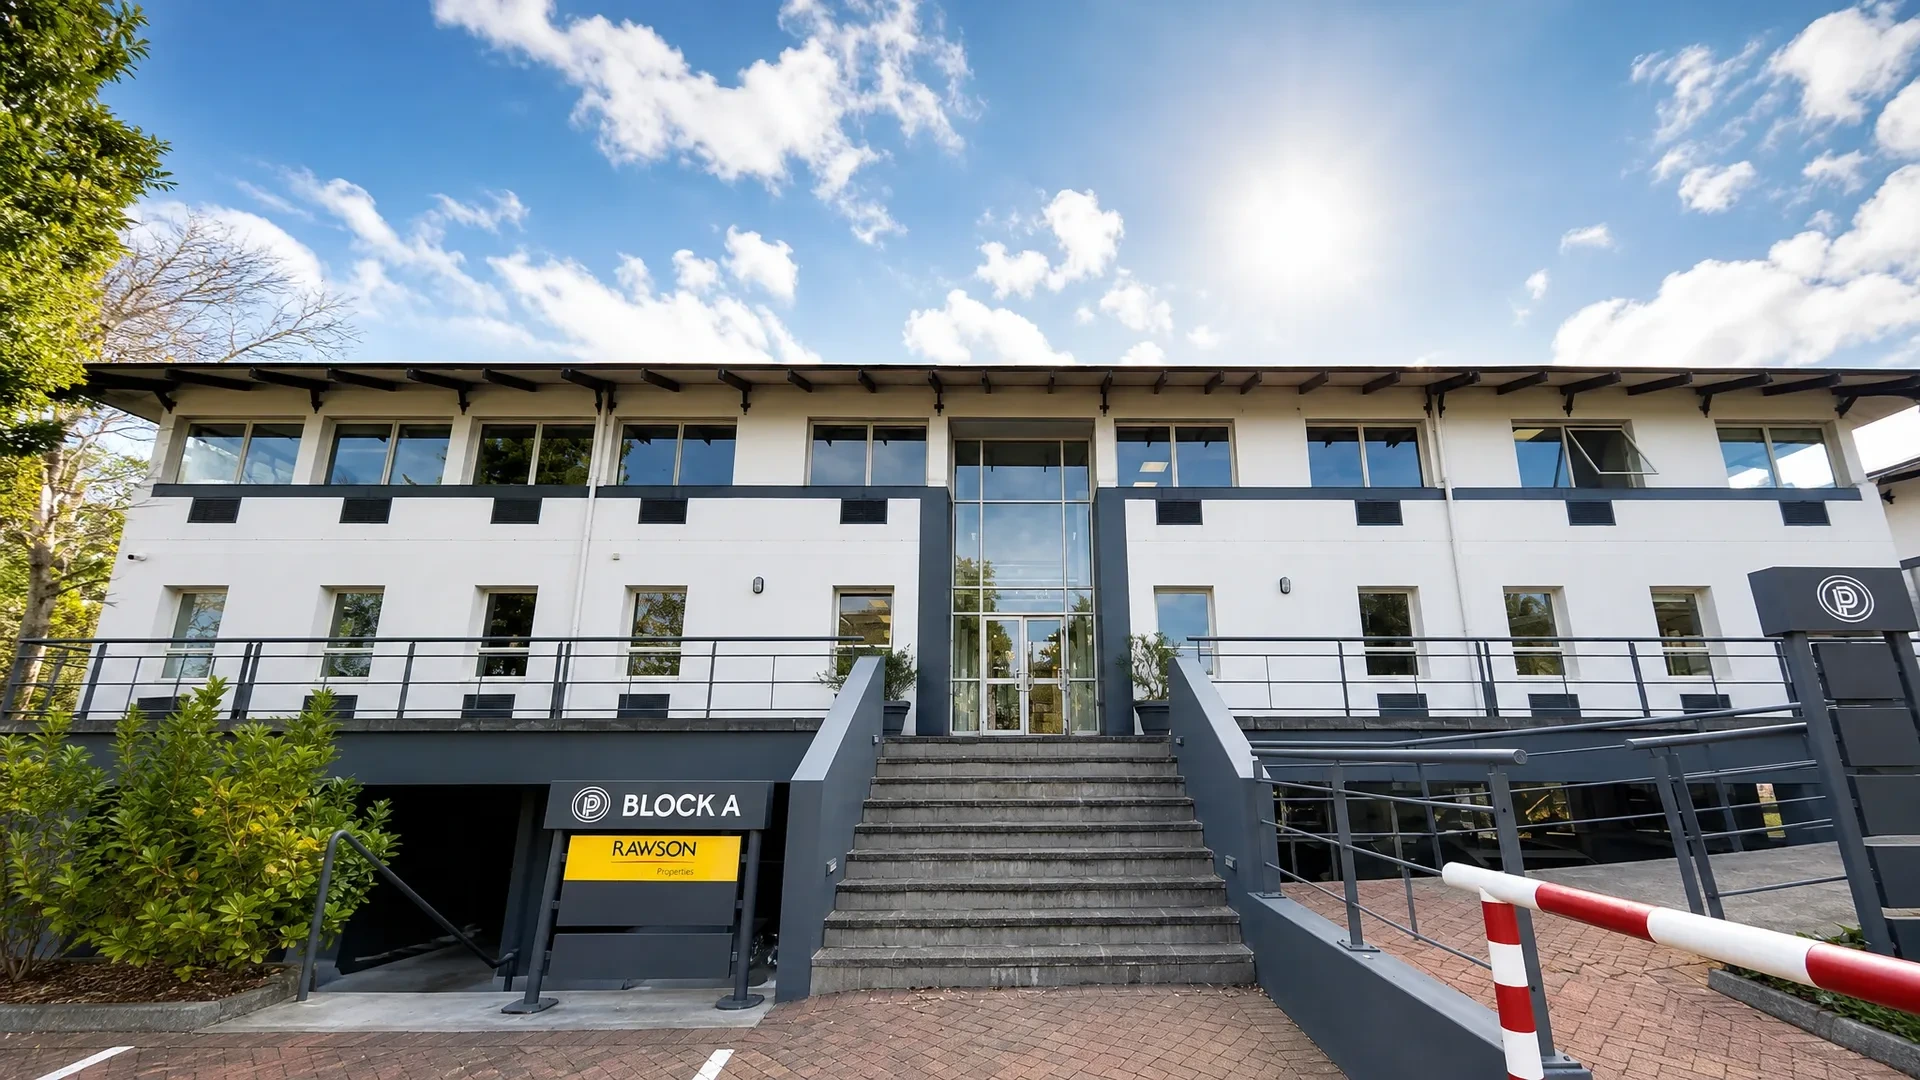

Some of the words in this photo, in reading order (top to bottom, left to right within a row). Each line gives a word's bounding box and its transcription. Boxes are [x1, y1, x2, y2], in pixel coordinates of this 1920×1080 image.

[622, 794, 715, 817] BLOCK
[721, 794, 741, 817] A
[612, 840, 697, 857] RAWSON
[656, 867, 694, 877] Properties
